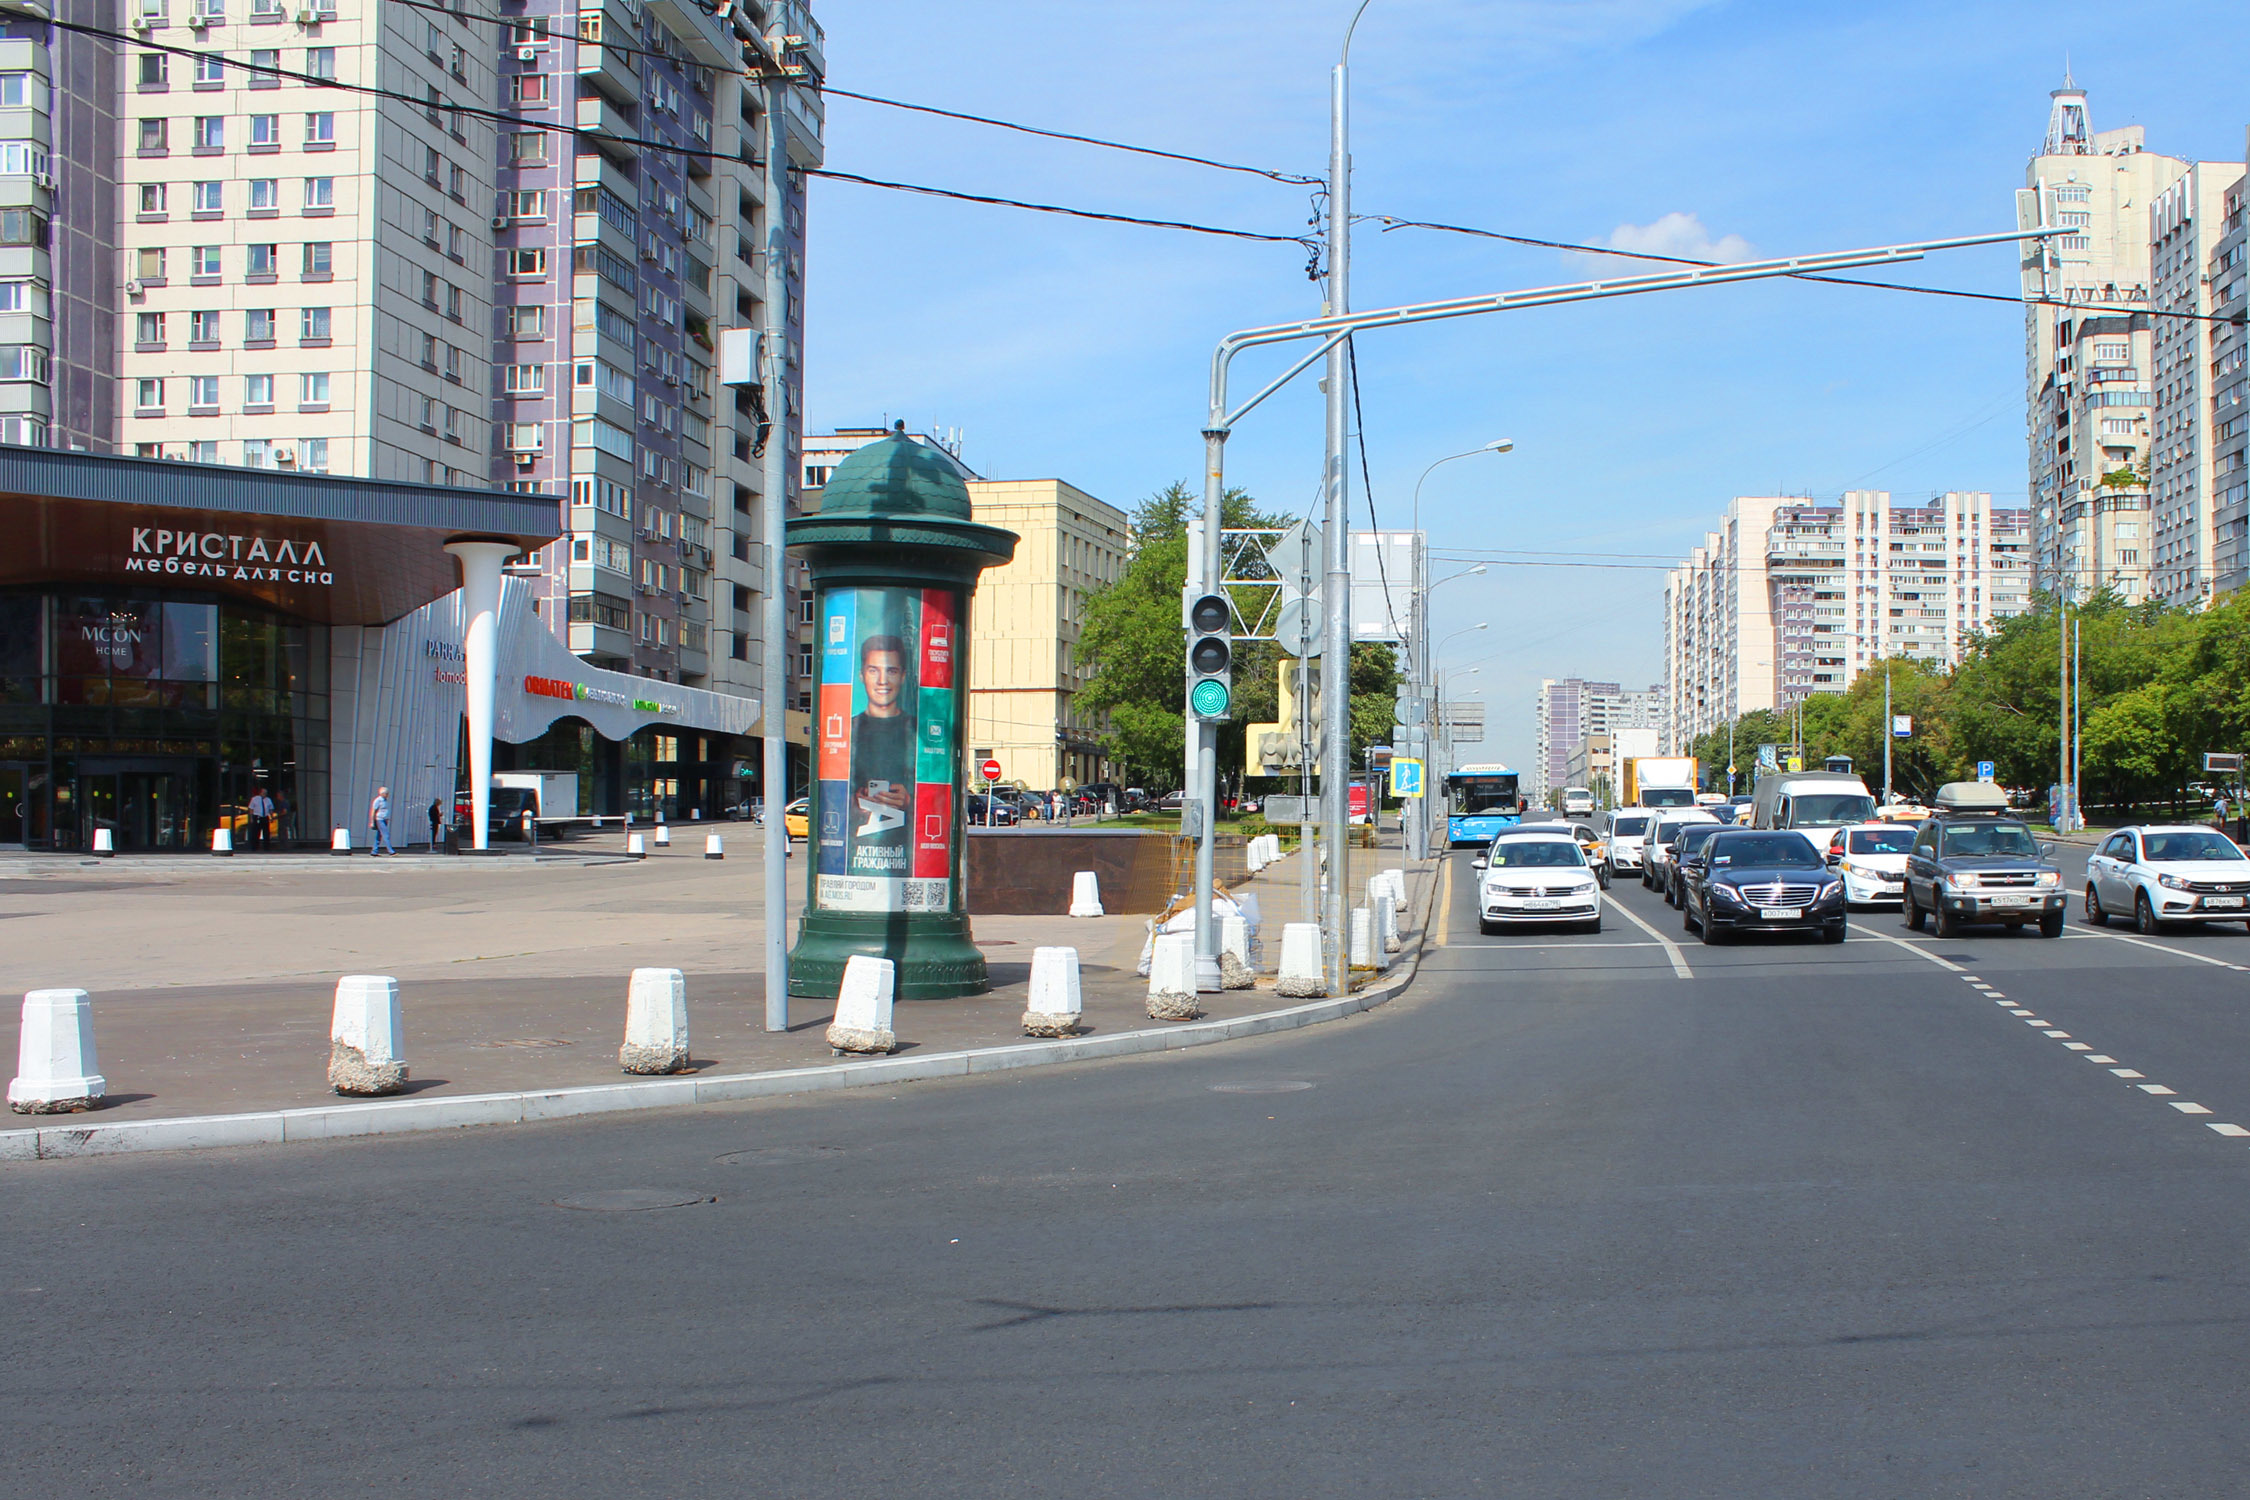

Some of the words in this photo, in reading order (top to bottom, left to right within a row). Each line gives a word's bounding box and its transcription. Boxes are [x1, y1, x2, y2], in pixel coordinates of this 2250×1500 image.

[131, 527, 326, 567] КРИСТАЛЛ
[125, 556, 226, 577] мебель
[233, 566, 280, 581] для
[287, 569, 334, 585] сна
[524, 674, 574, 701] ORMATEK
[856, 845, 904, 858] АКТИВНЫЙ
[852, 856, 907, 870] ГРАЖДАНИН
[845, 880, 876, 891] ГОРОДОМ
